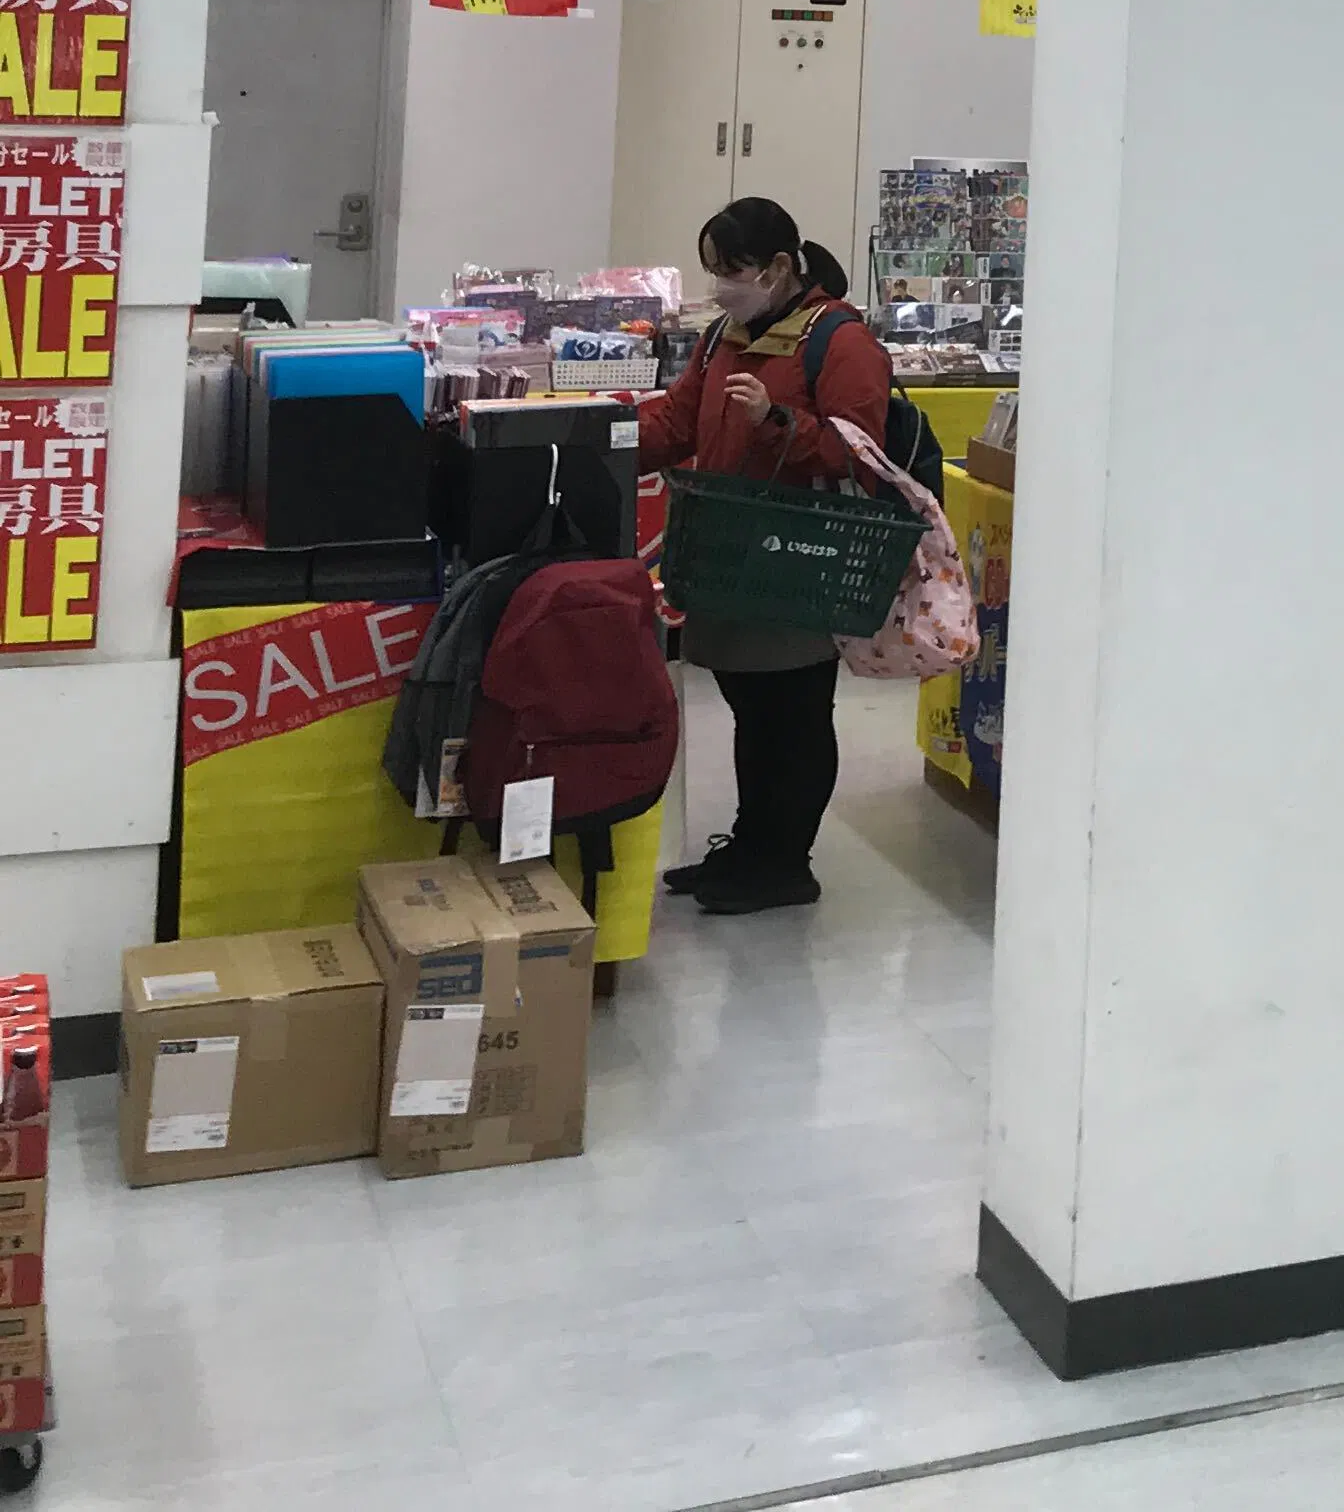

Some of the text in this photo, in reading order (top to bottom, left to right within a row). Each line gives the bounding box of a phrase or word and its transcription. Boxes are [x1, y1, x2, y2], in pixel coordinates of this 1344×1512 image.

[0, 142, 70, 167] セール
[185, 604, 419, 732] SALE
